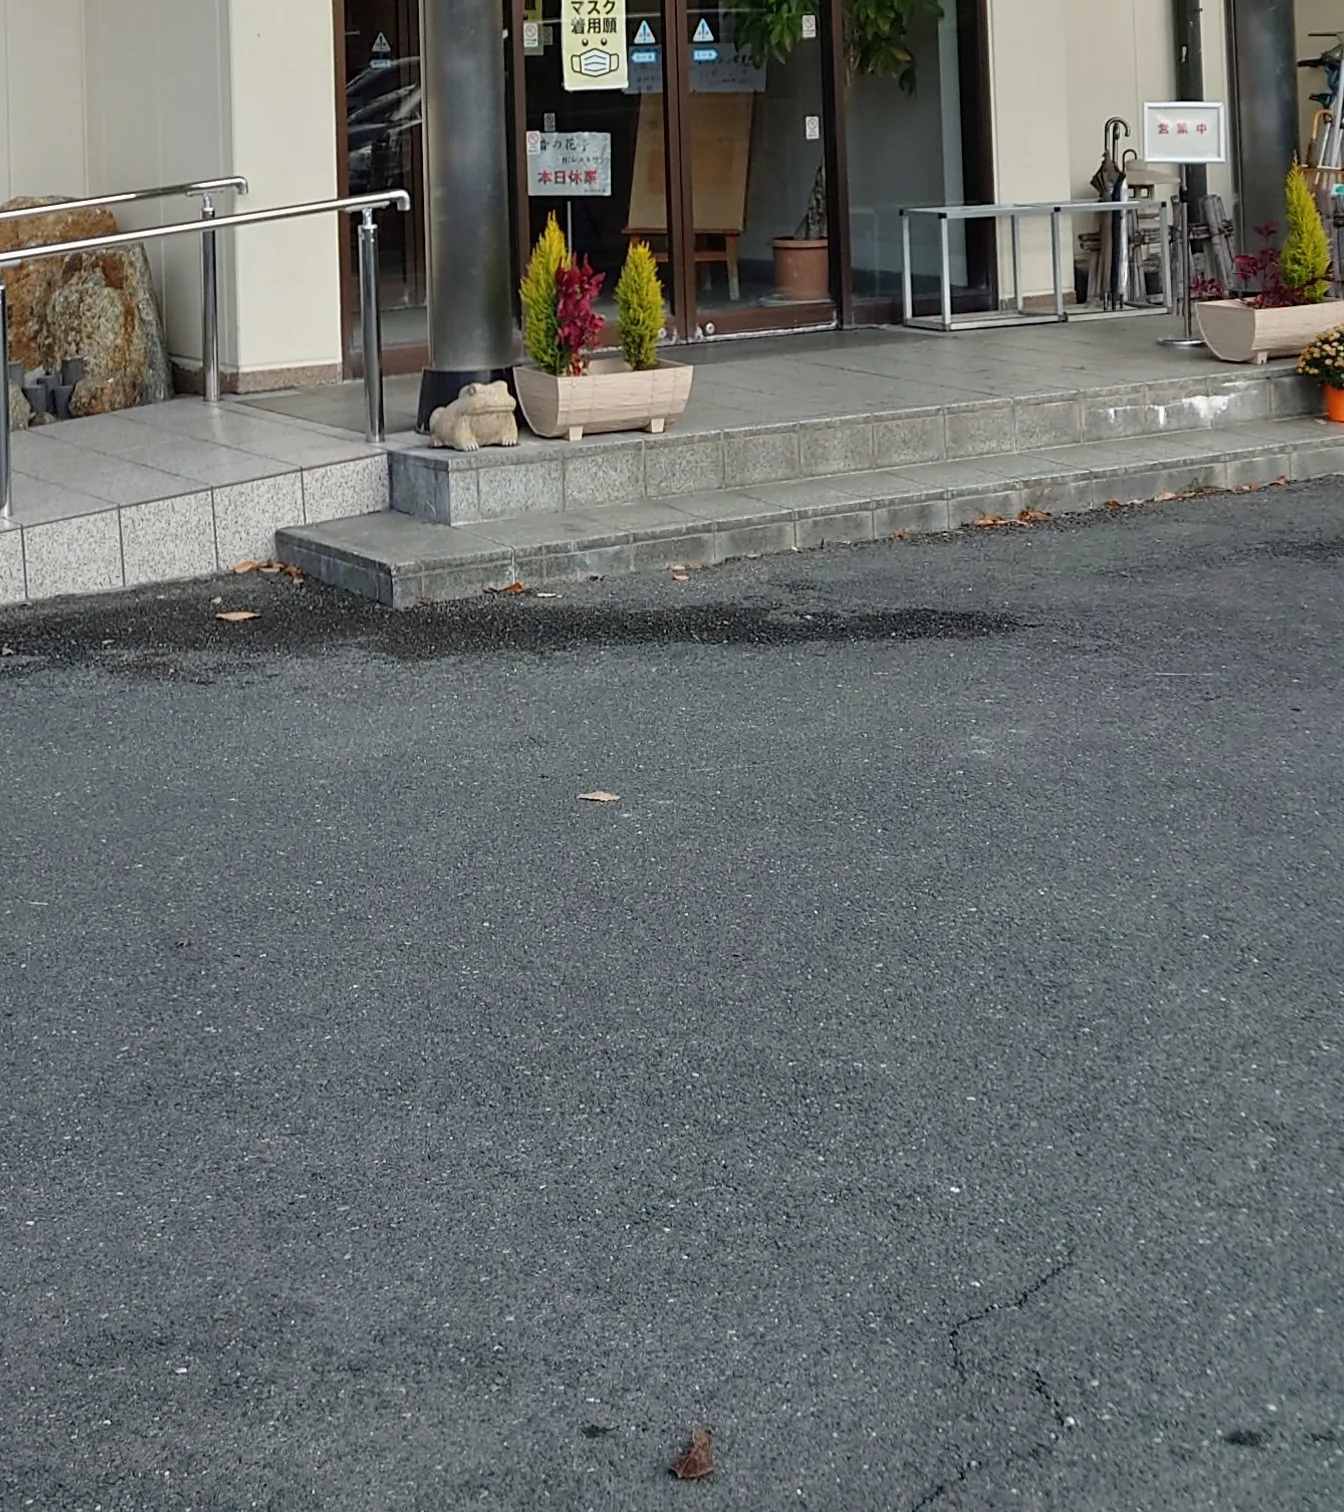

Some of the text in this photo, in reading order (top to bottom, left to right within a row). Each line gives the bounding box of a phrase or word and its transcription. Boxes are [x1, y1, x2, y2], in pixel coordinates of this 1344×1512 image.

[570, 0, 616, 15] マスク
[570, 17, 618, 35] 着用願
[1157, 122, 1208, 136] 営業中
[537, 169, 598, 185] 本日休業
